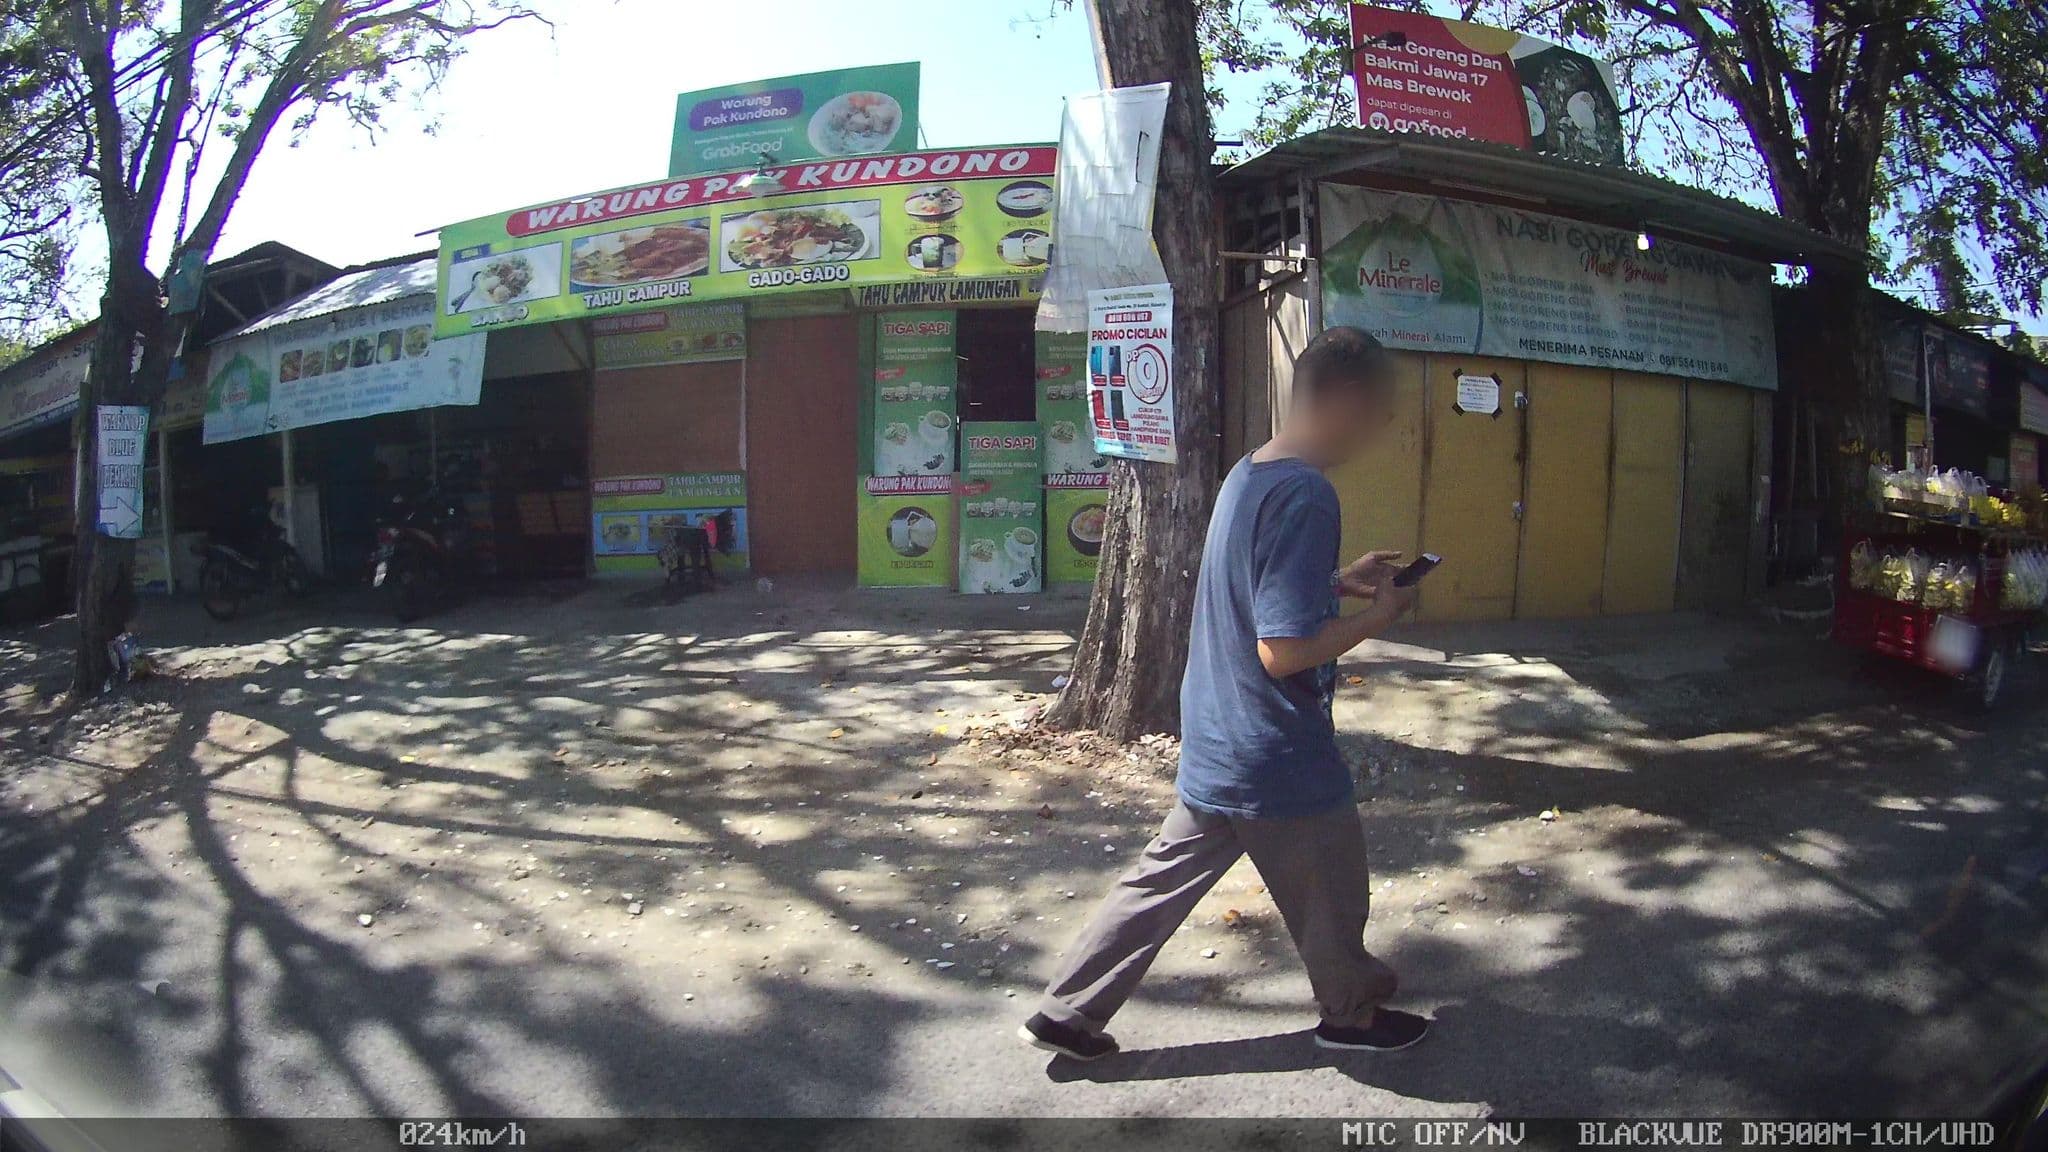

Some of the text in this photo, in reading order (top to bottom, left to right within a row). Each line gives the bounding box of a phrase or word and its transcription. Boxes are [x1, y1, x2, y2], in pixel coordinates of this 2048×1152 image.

[1405, 41, 1468, 67] Goreng
[1471, 52, 1502, 71] Dan
[1364, 53, 1488, 87] Bakmi Jawa 17
[1366, 73, 1472, 103] Mas Brewok
[721, 94, 771, 111] Warung
[1367, 97, 1452, 119] dapat dipesan di
[703, 106, 788, 127] Pak Kundono
[702, 137, 783, 161] GrabFood
[528, 182, 690, 229] WARUNG
[797, 150, 1030, 187] KUNDONO
[1387, 251, 1410, 273] Le
[748, 264, 850, 288] GADO-GADO
[1359, 267, 1441, 293] Minerale
[583, 280, 692, 309] TAHU CAMPUR
[858, 284, 889, 305] TAHU
[894, 282, 946, 303] CAMPUR
[950, 279, 1020, 301] LAMONGAN
[884, 321, 951, 336] TIGA SAPI
[1091, 327, 1167, 341] PROMO CICILAN
[1391, 328, 1430, 342] Mineral
[1434, 333, 1466, 344] Alami
[1126, 349, 1140, 362] DP
[1519, 337, 1587, 356] MENERIMA
[1590, 346, 1644, 362] PESANAN
[108, 438, 136, 456] BLUE
[968, 435, 1037, 450] TIGA SAPI
[867, 476, 900, 492] WARUNG
[901, 475, 916, 491] PAK
[1047, 474, 1102, 487] WARUNG
